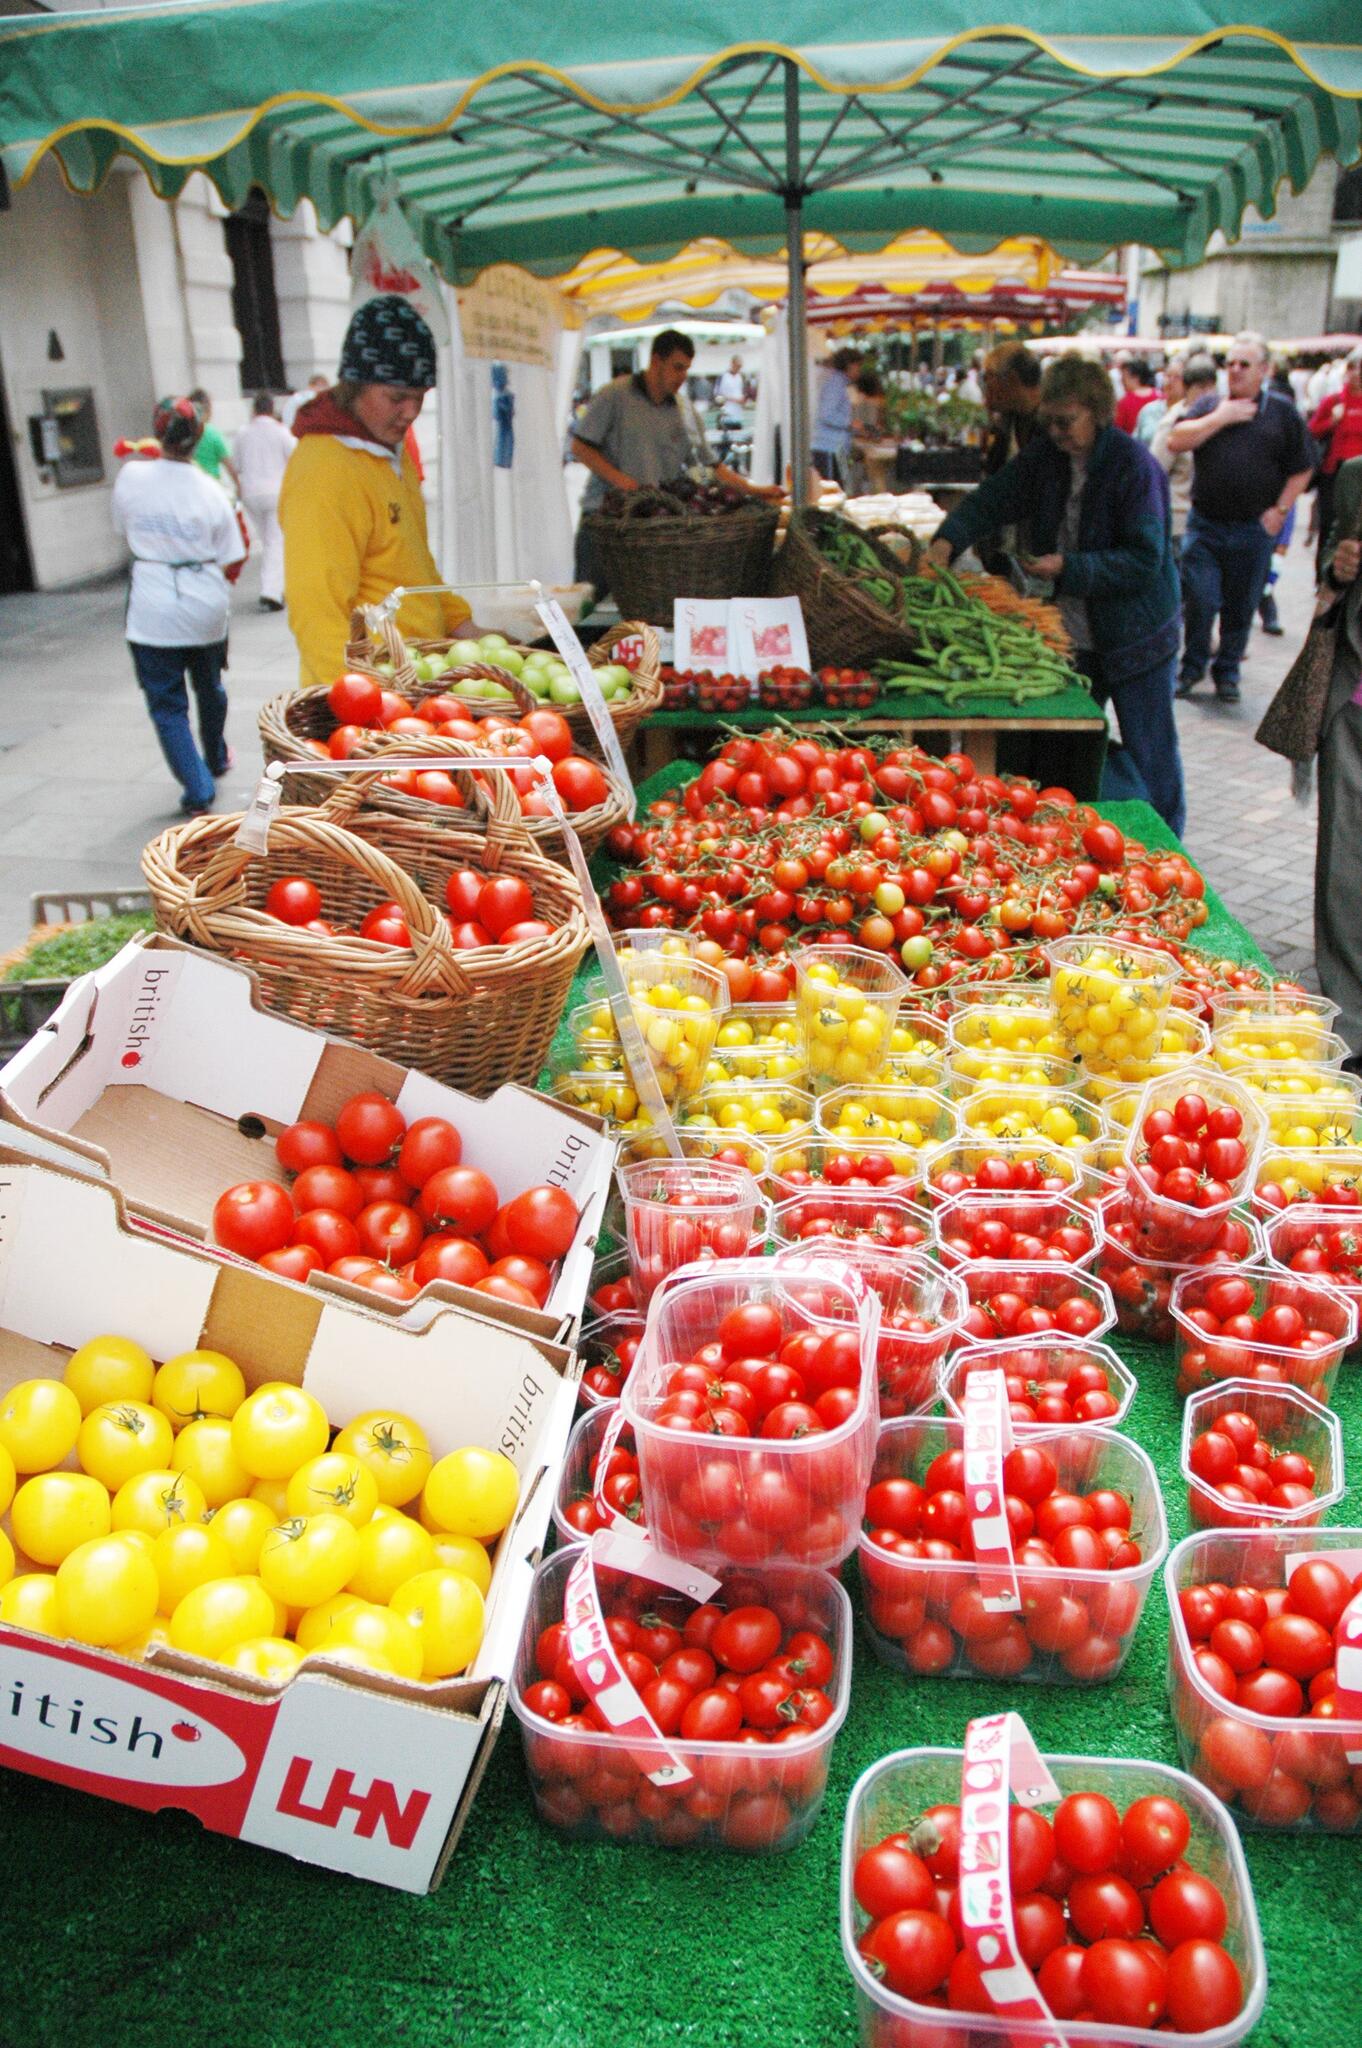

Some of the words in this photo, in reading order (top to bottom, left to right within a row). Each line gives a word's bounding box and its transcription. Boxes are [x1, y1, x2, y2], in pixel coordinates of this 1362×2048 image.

[125, 970, 169, 1048] british
[546, 1134, 590, 1191] briti
[0, 1681, 163, 1759] itish
[275, 1755, 432, 1850] LHN
